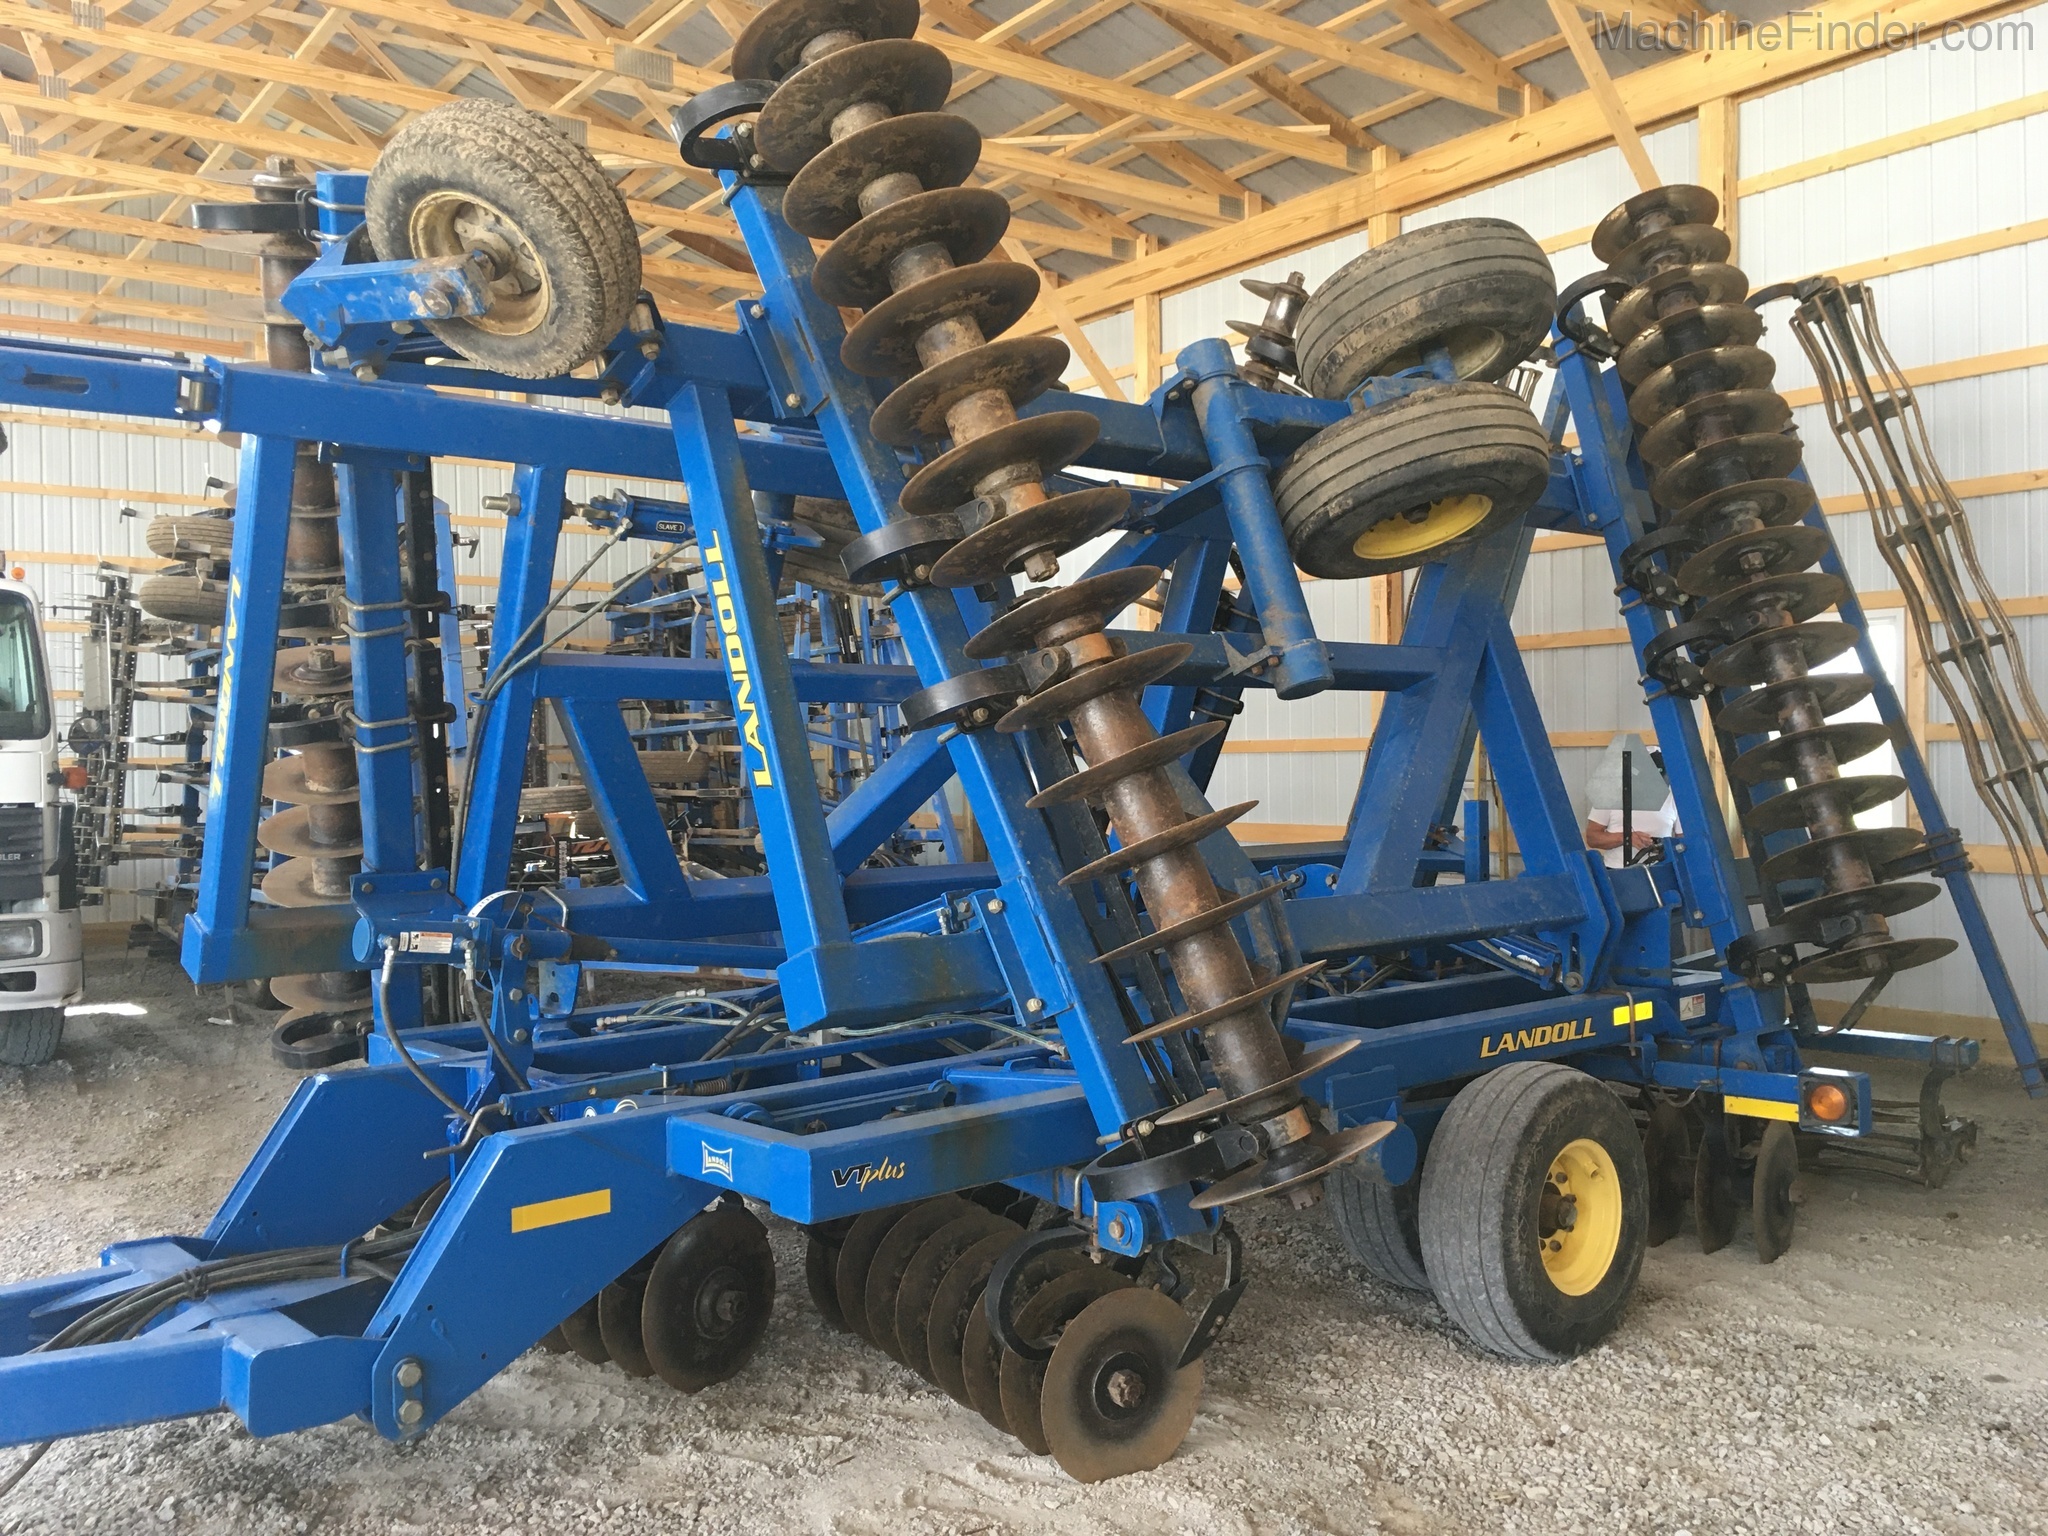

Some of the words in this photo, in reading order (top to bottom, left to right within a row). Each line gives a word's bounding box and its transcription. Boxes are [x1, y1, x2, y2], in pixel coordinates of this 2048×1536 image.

[658, 523, 677, 531] SLAVE
[211, 574, 241, 797] LANDOLL
[704, 529, 774, 789] LANDOLL
[1479, 1016, 1597, 1059] LANDOLL
